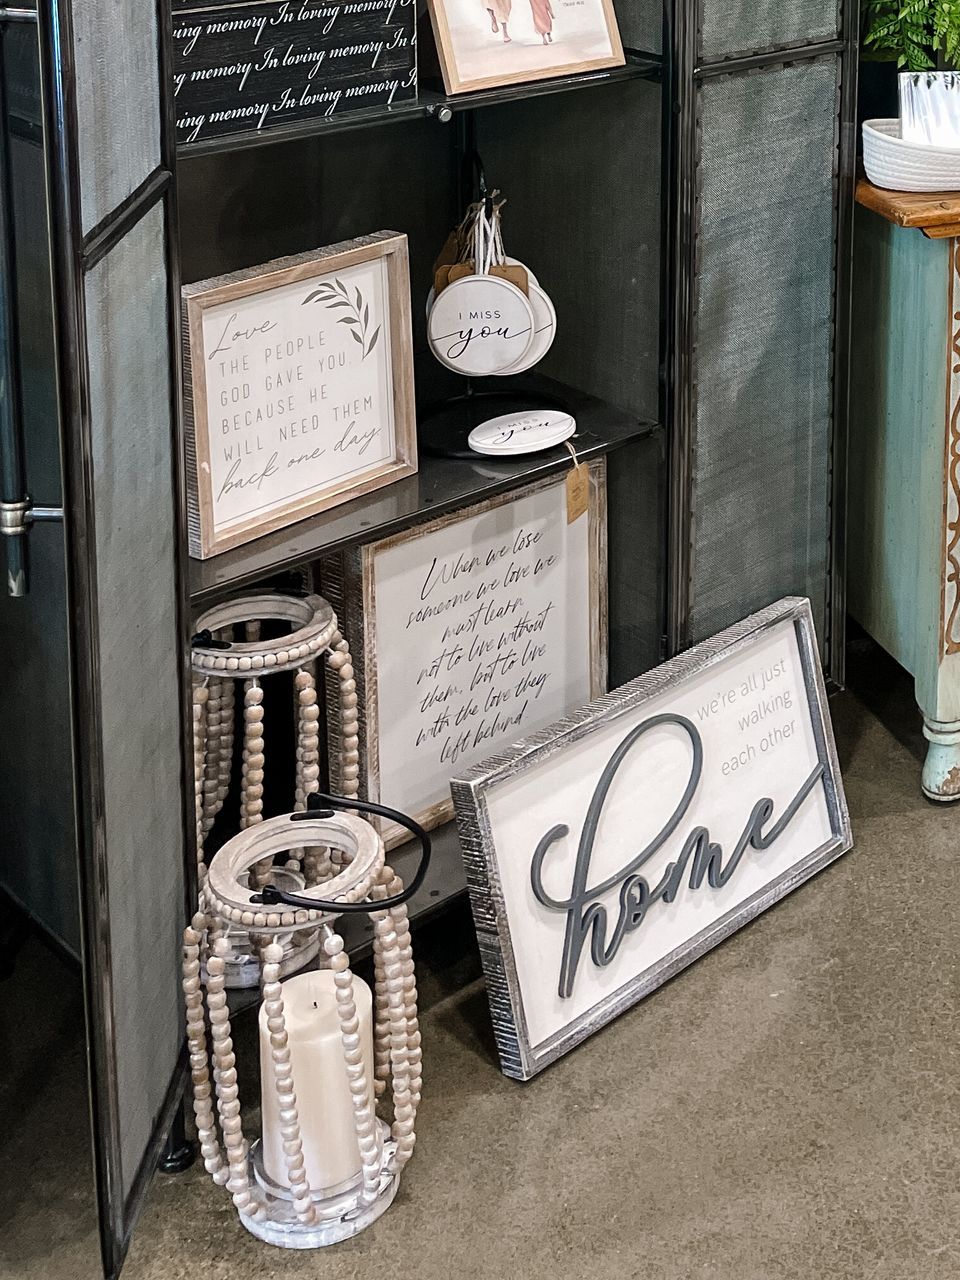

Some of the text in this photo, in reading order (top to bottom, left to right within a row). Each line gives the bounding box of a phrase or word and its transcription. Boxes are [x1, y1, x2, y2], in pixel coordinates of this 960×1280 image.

[207, 14, 266, 45] memory
[270, 2, 295, 25] In
[297, 0, 340, 35] loving
[191, 58, 251, 91] memory
[255, 47, 279, 71] In
[282, 44, 326, 80] loving
[329, 38, 384, 68] memory
[208, 313, 278, 361] Love
[469, 310, 501, 319] MISS
[219, 330, 326, 379] THE PEOPLE
[432, 326, 532, 359] you
[220, 365, 304, 407] GOD GAVE
[222, 384, 328, 435] BECAUSE HE
[223, 395, 374, 462] WILL NEED THEM
[216, 447, 327, 504] back one
[420, 529, 544, 601] When we lose
[406, 554, 560, 629] someone we love we
[417, 601, 555, 684] not to live without
[442, 599, 525, 643] must learn
[470, 639, 547, 691] but to live
[697, 658, 786, 721] we're all just
[416, 671, 551, 747] with the love they
[738, 690, 792, 731] walking
[440, 730, 471, 763] left
[722, 720, 795, 775] each other
[531, 712, 825, 998] home
